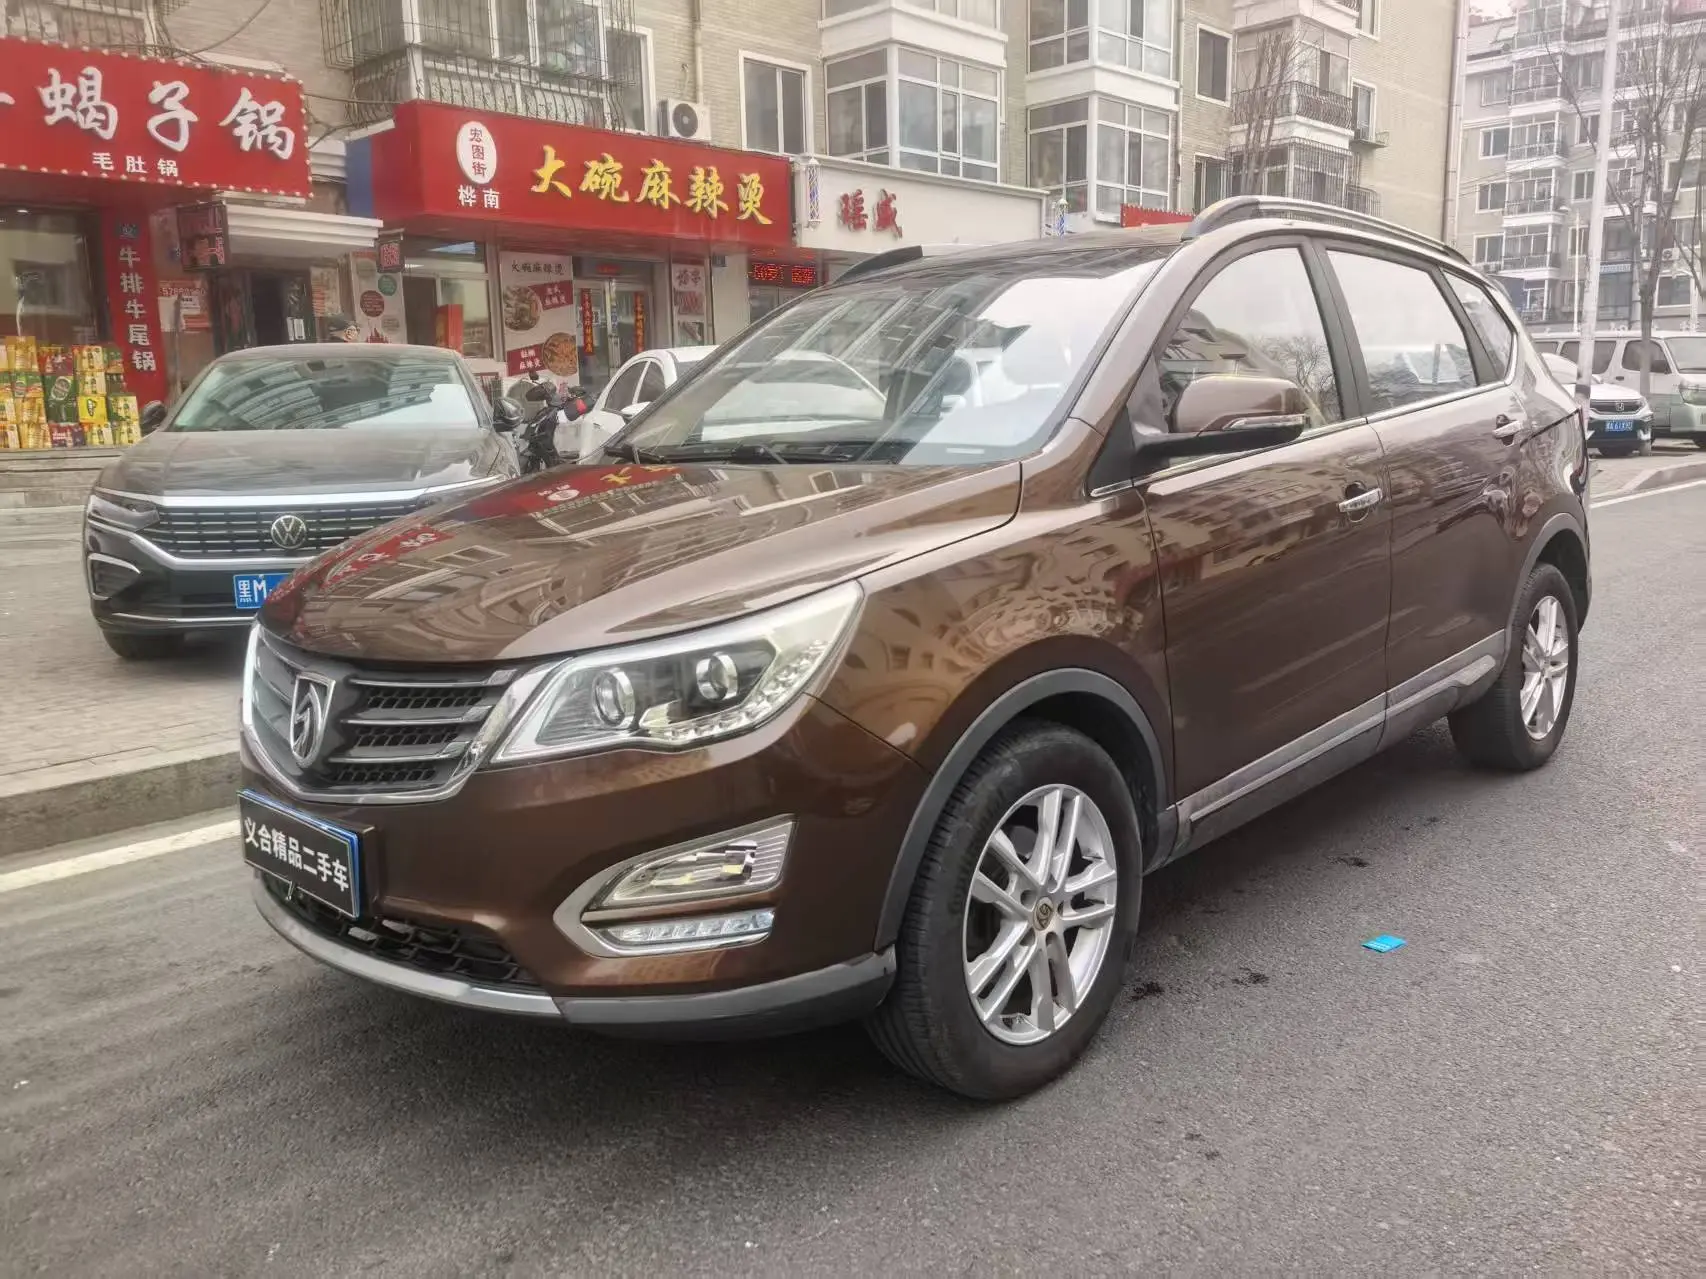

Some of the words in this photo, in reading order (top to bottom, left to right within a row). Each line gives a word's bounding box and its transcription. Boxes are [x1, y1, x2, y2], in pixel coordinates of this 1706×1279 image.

[0, 66, 296, 161] 蝎子锅
[92, 151, 180, 178] 毛肚锅
[456, 184, 501, 209] 桦南
[530, 144, 774, 226] 大碗麻辣烫
[119, 245, 157, 372] 牛排牛尾锅
[243, 816, 350, 892] 义合精品二手车
